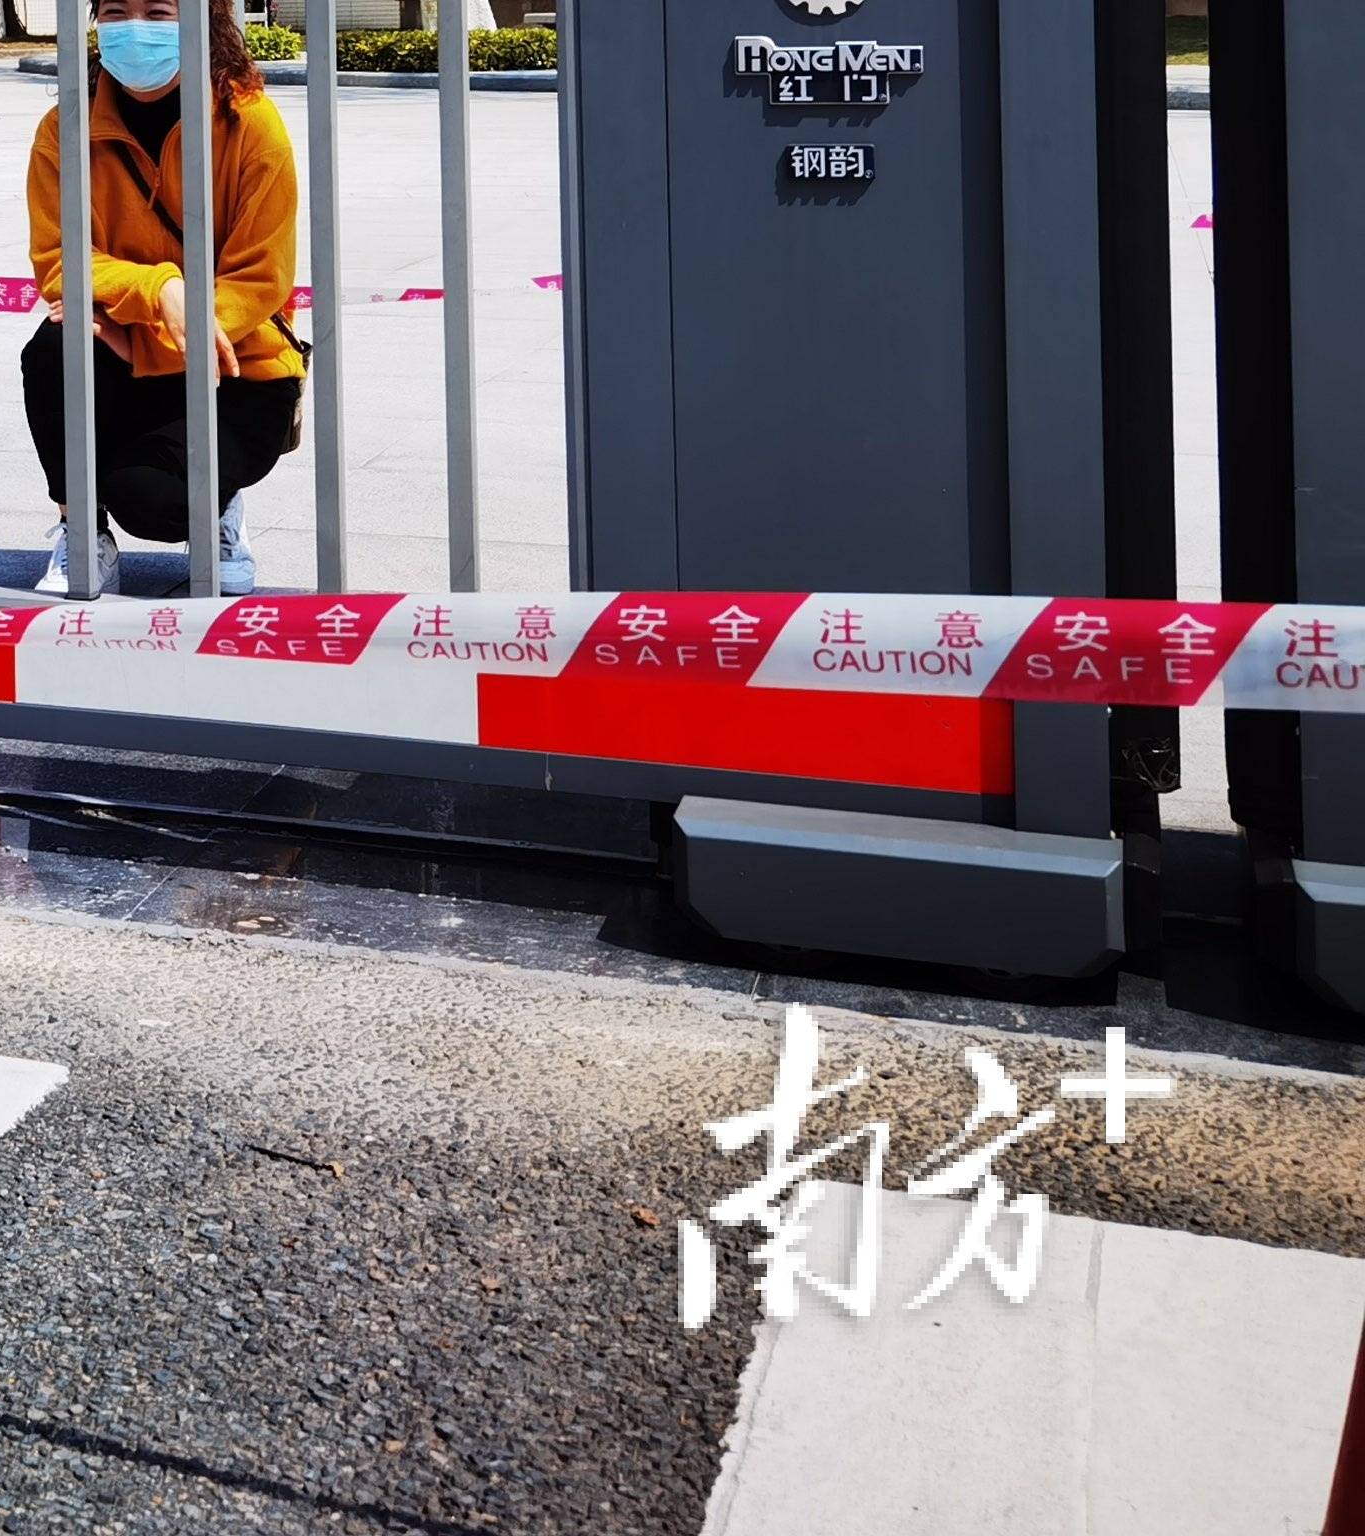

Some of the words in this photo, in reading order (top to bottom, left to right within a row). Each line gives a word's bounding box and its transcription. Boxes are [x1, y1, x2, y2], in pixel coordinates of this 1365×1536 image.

[779, 75, 878, 102] 红门
[791, 146, 865, 178] 钢韵
[59, 606, 184, 640] 注意
[235, 603, 362, 642] 安全
[413, 604, 557, 642] 注意
[618, 604, 760, 646] 安全
[819, 608, 984, 649] 注意
[1053, 611, 1217, 657] 安全
[1284, 618, 1338, 658] 注
[215, 638, 349, 658] SAFE
[406, 640, 550, 664] CAUTION
[594, 644, 742, 670] SAFE
[812, 649, 974, 677] CAUTION
[1026, 653, 1194, 685] SAFE
